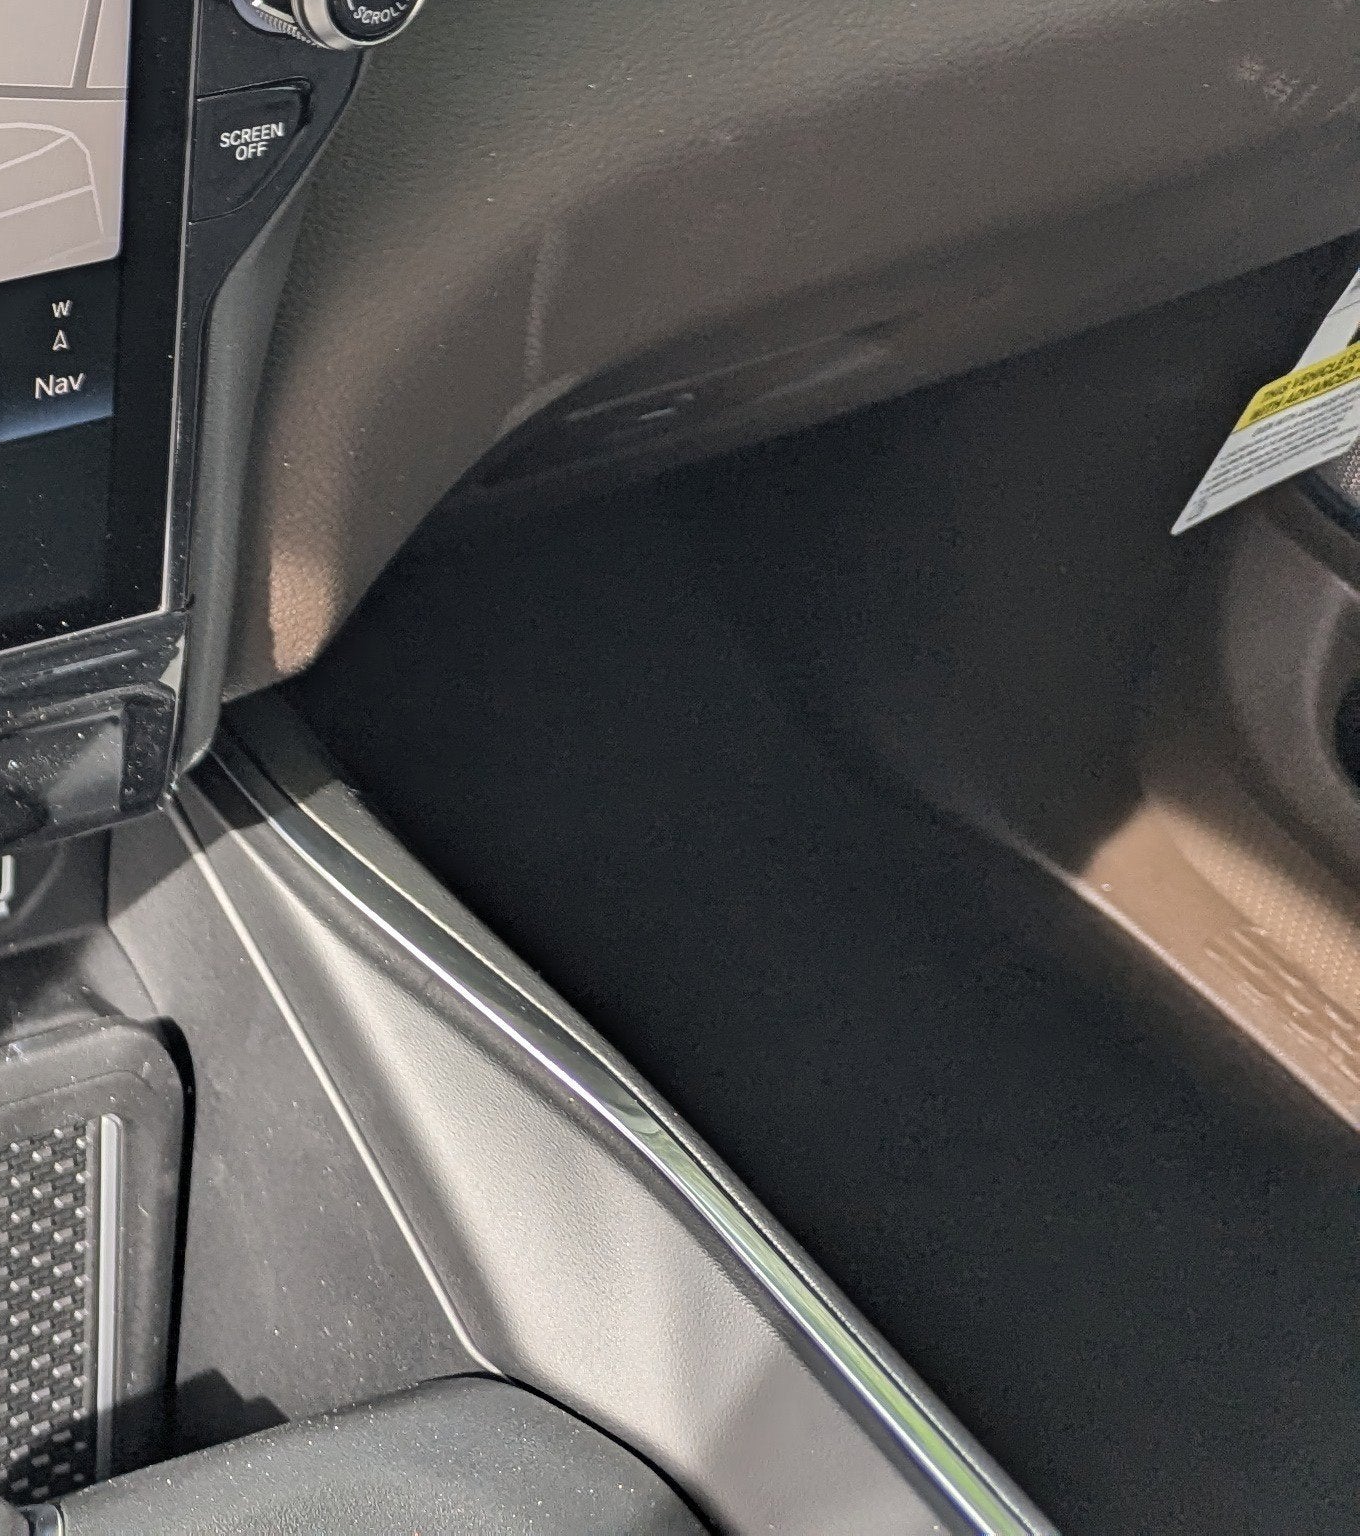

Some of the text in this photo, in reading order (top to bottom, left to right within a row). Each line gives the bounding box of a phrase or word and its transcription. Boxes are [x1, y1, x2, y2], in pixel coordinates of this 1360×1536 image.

[353, 0, 409, 25] SCROLL
[219, 121, 285, 149] SCREEN
[234, 141, 269, 161] OFF
[51, 299, 73, 318] W
[34, 371, 85, 400] Nav
